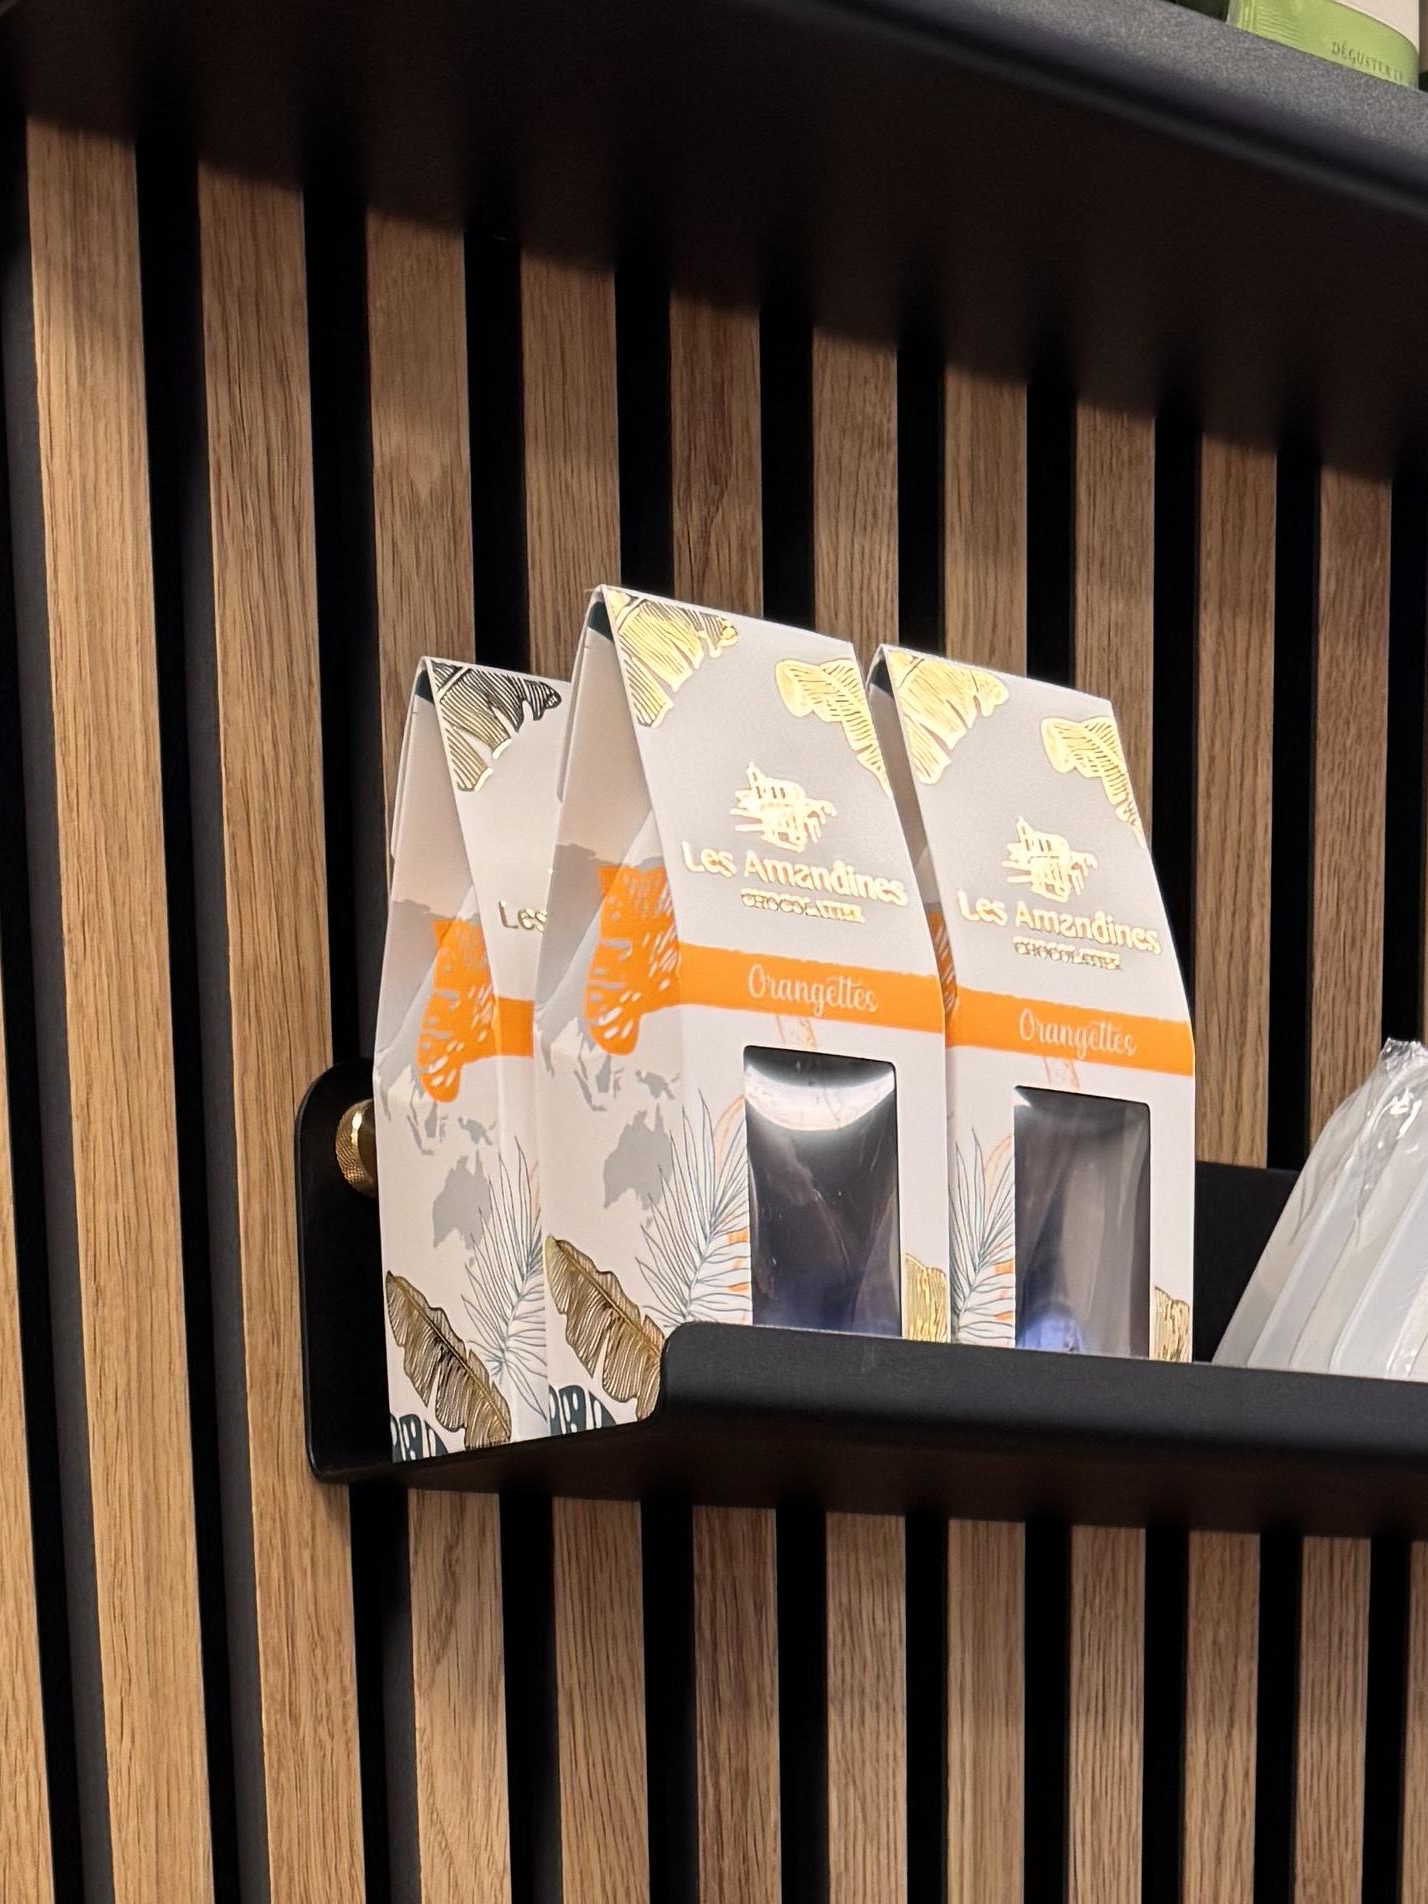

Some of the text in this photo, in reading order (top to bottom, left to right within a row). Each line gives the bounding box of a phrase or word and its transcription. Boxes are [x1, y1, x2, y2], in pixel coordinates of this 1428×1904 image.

[682, 841, 909, 907] Les Amandines
[957, 889, 1162, 956] Les Amandines
[748, 963, 879, 1017] Orangettes
[1019, 1008, 1138, 1060] Orangettes
